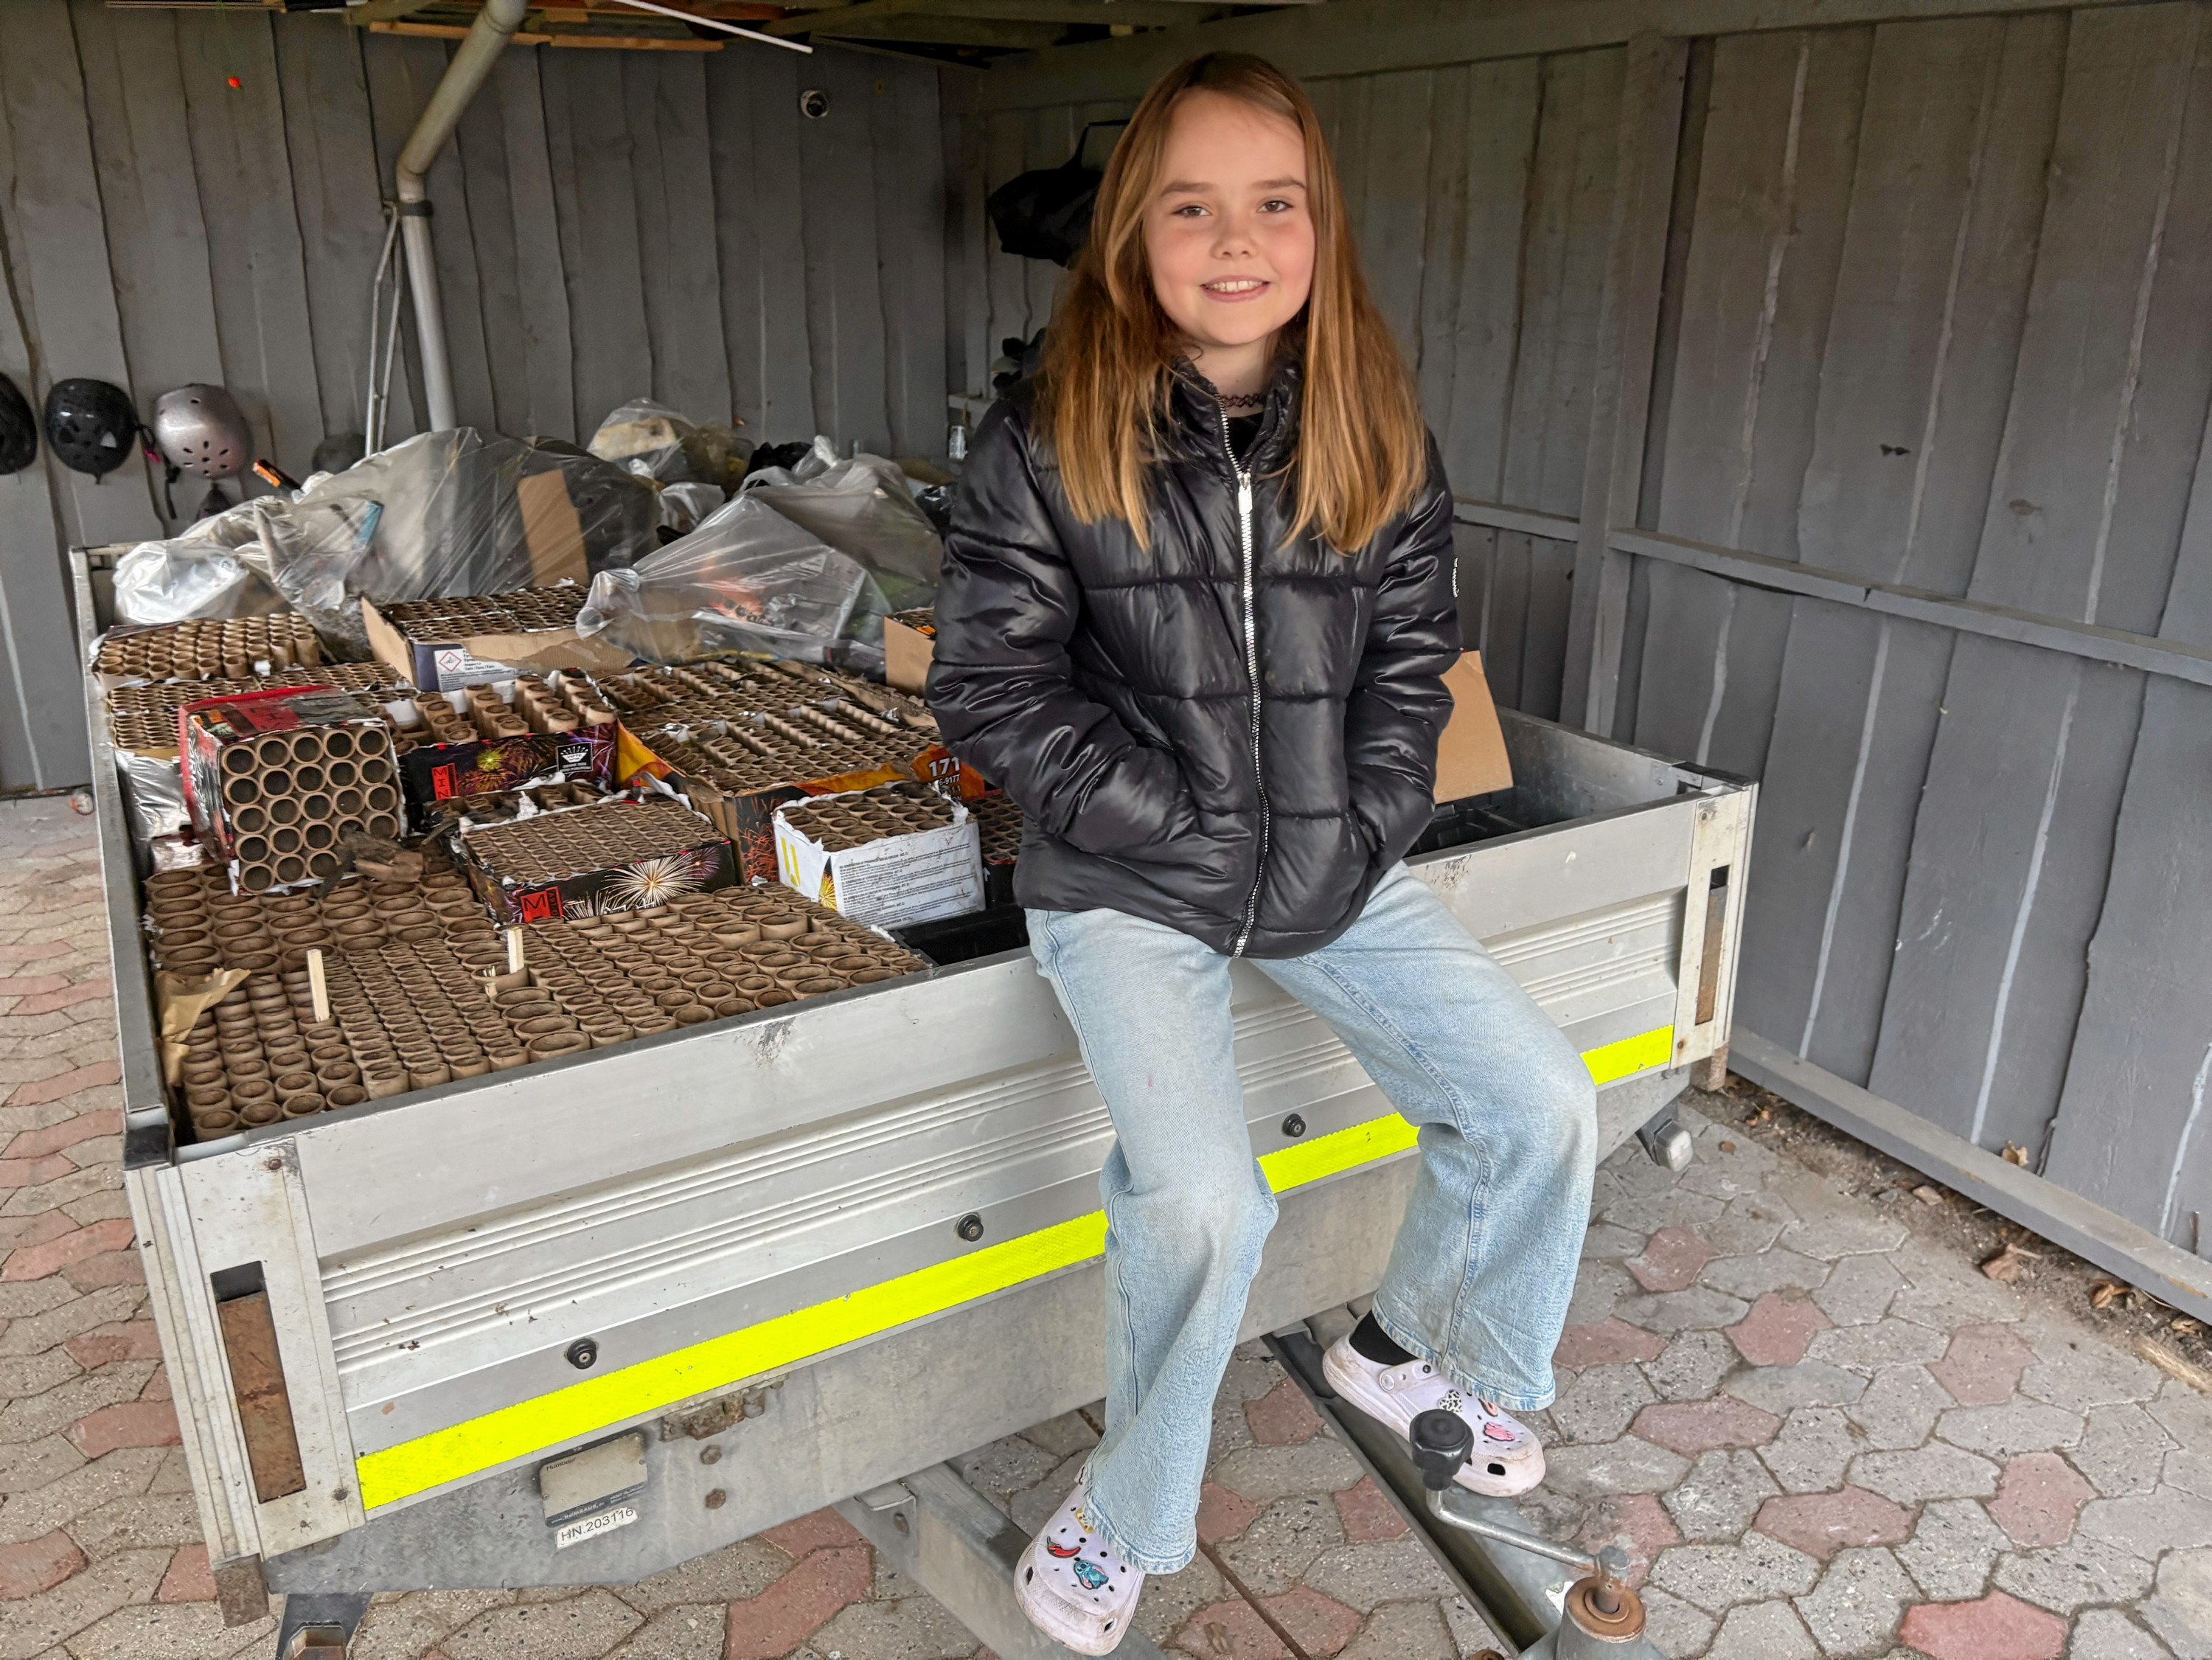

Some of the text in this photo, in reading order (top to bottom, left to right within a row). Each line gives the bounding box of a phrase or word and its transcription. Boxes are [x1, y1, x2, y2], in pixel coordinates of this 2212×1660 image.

[929, 757, 960, 777] 171
[524, 893, 547, 920] M
[561, 1509, 633, 1541] HN.203116
